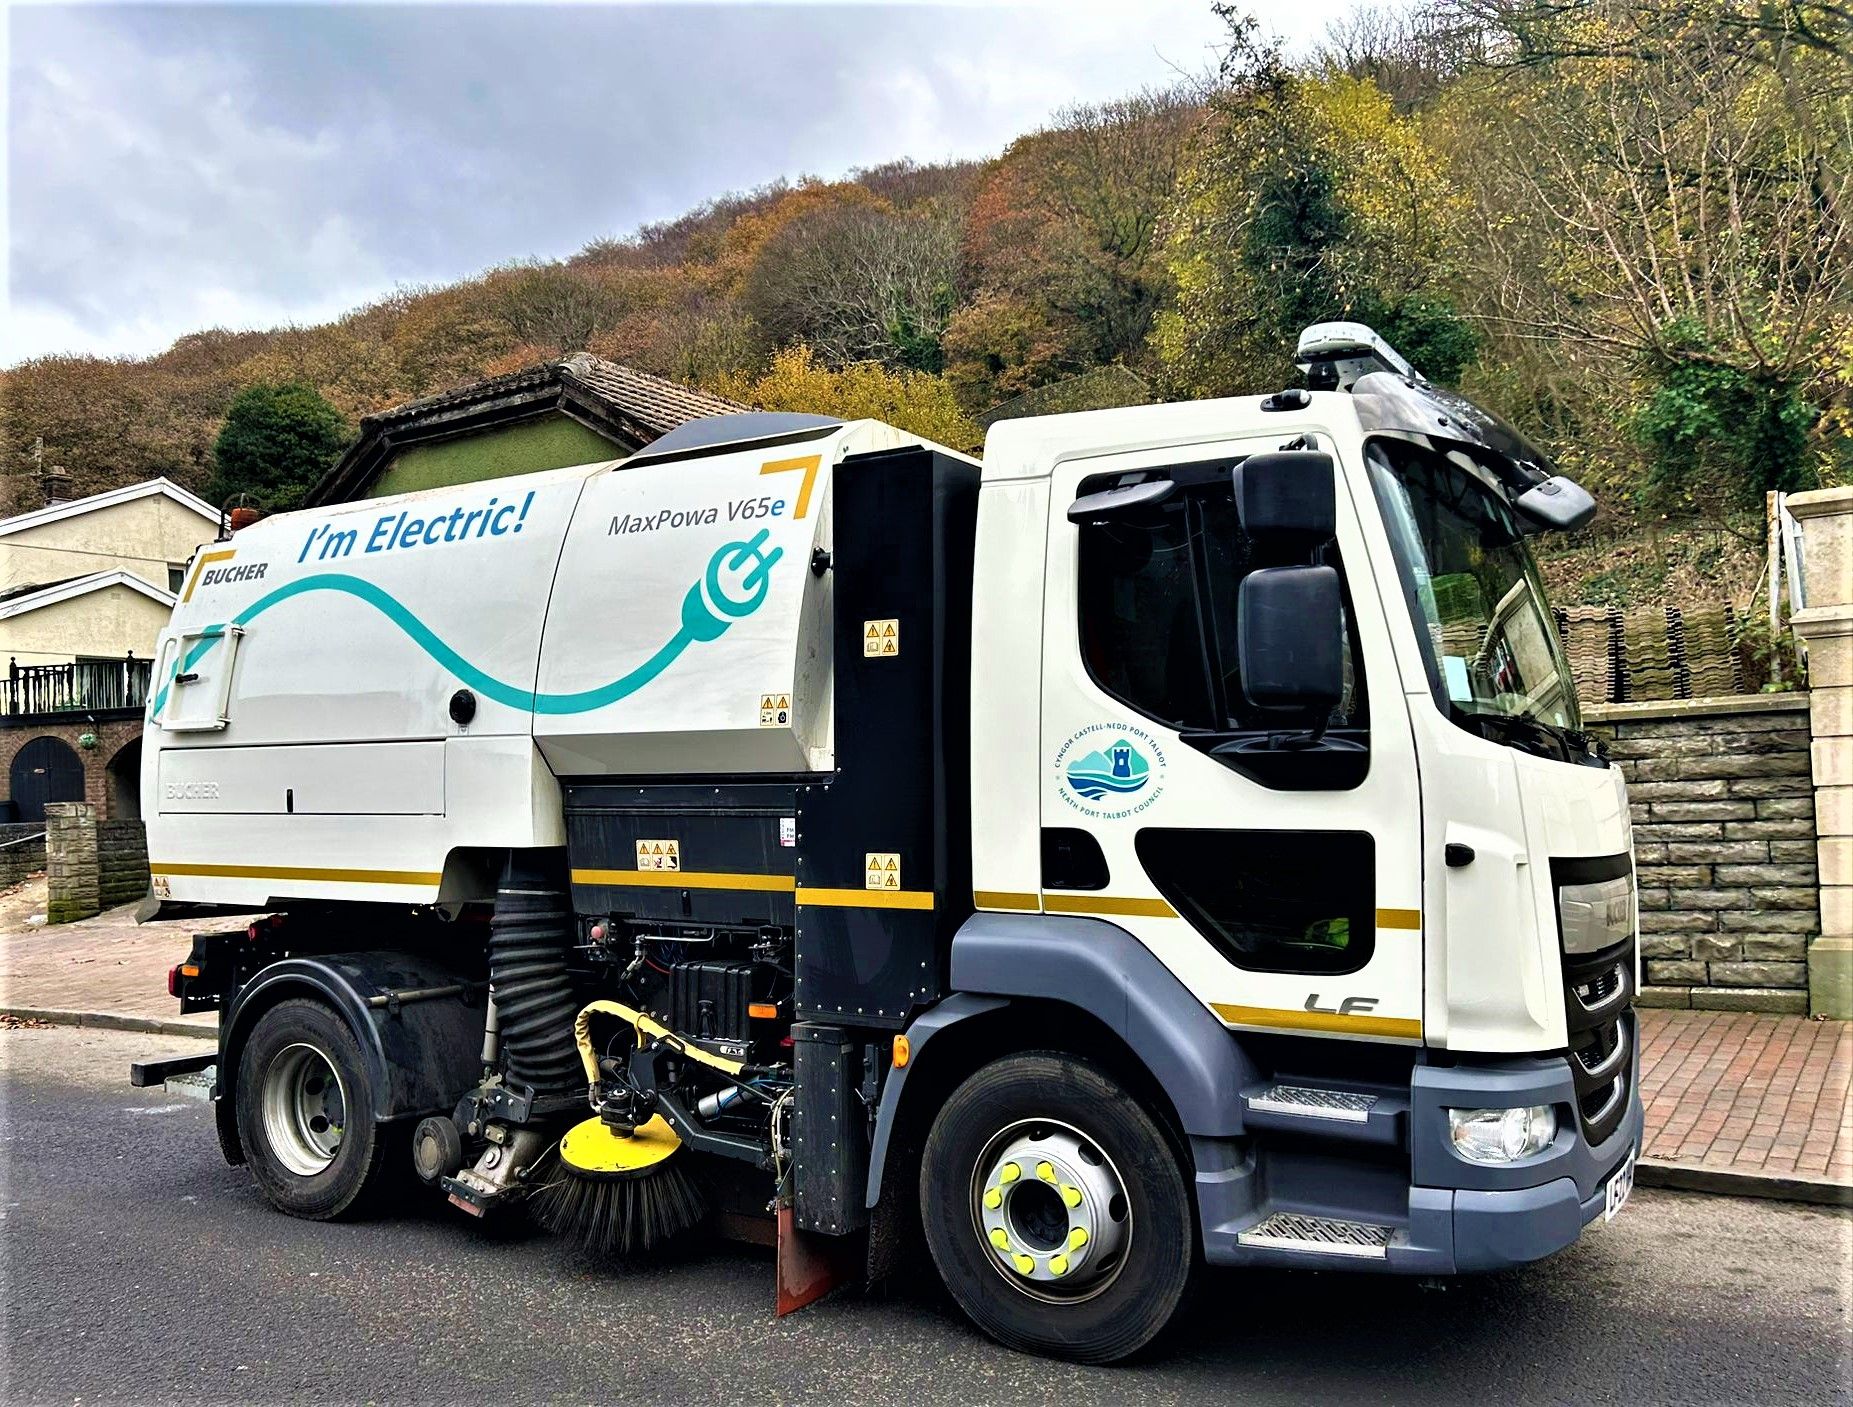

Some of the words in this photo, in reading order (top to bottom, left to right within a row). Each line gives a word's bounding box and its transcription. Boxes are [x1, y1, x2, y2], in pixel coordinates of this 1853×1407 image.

[364, 490, 536, 554] Electric!
[607, 508, 718, 536] MaxPowa
[727, 496, 786, 522] V65e
[202, 562, 269, 586] BUCHER
[1054, 738, 1074, 769] CYNGOR
[1074, 722, 1128, 741] CASTELL-NEDD
[1129, 726, 1149, 742] PORT
[1148, 739, 1167, 768] TALBOT
[1058, 787, 1080, 810] NEATH
[1080, 805, 1100, 819] PORT
[1103, 809, 1133, 820] TALBOT
[1133, 785, 1164, 814] COUNCIL
[1304, 993, 1380, 1015] LF
